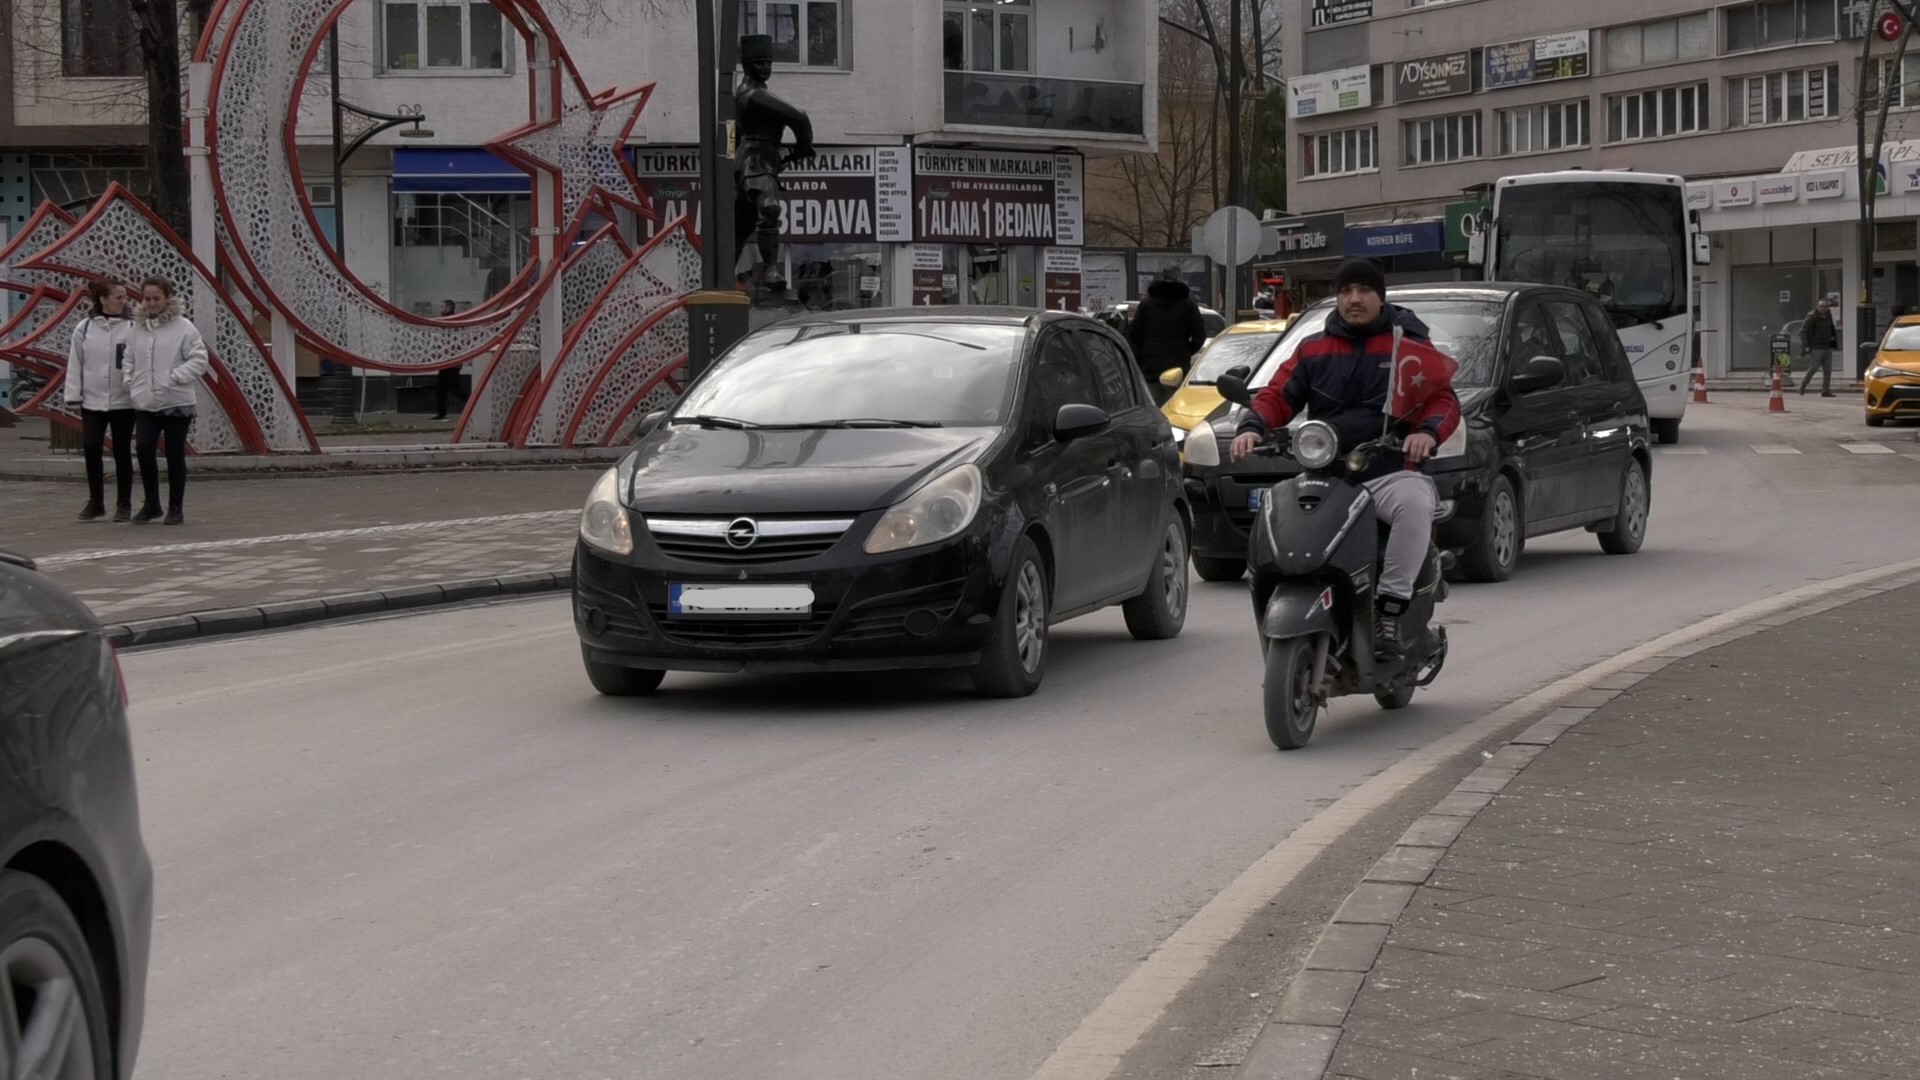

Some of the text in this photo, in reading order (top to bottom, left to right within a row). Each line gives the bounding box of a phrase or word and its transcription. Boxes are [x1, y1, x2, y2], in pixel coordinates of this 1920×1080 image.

[642, 151, 701, 171] TÜRKİ
[918, 155, 1052, 175] TÜRKİYE'NİN MARKALARI
[950, 181, 1043, 192] TÜM AYAKKABILARDA
[918, 196, 1053, 239] 1 ALANA 1 BEDAVA
[1367, 232, 1413, 246] KORNER BÜFE
